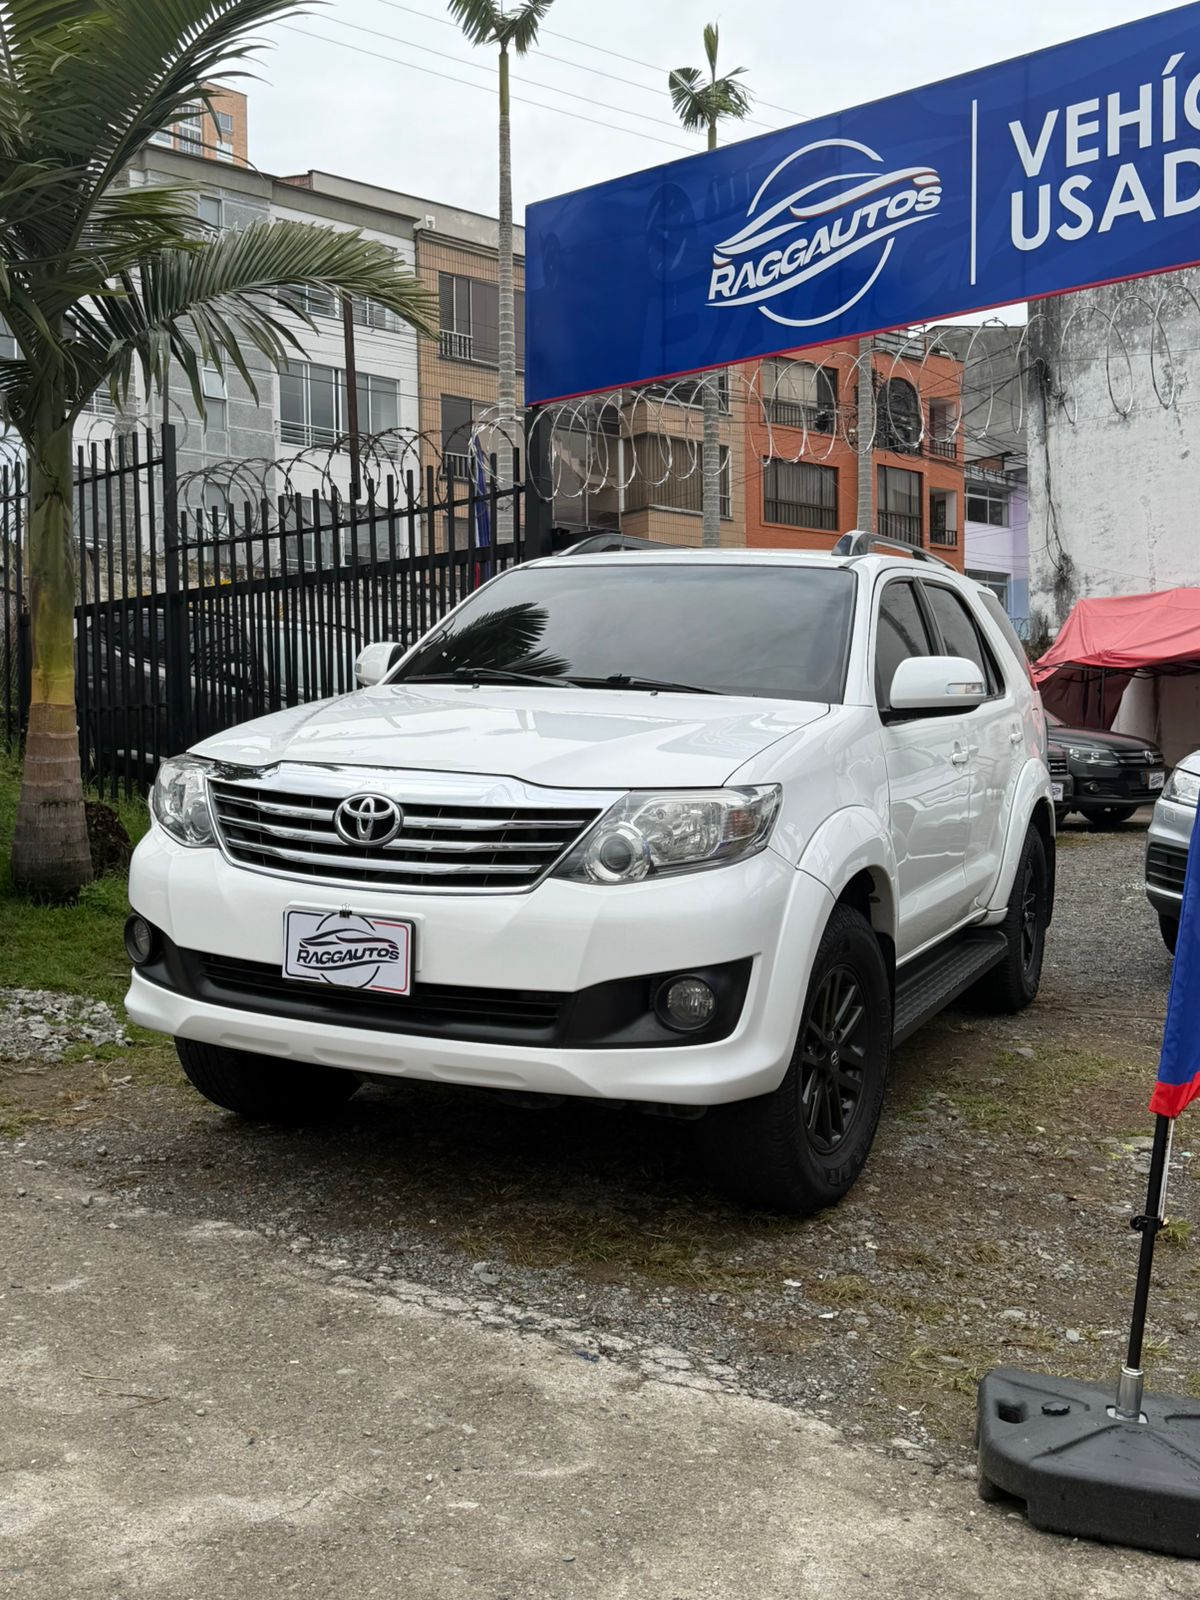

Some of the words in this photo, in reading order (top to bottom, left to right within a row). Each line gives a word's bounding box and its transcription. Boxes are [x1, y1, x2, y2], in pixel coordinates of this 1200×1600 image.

[708, 186, 942, 300] RAGGAUTOS
[1011, 148, 1200, 251] USAD
[296, 947, 400, 965] RAGGAUTOS
